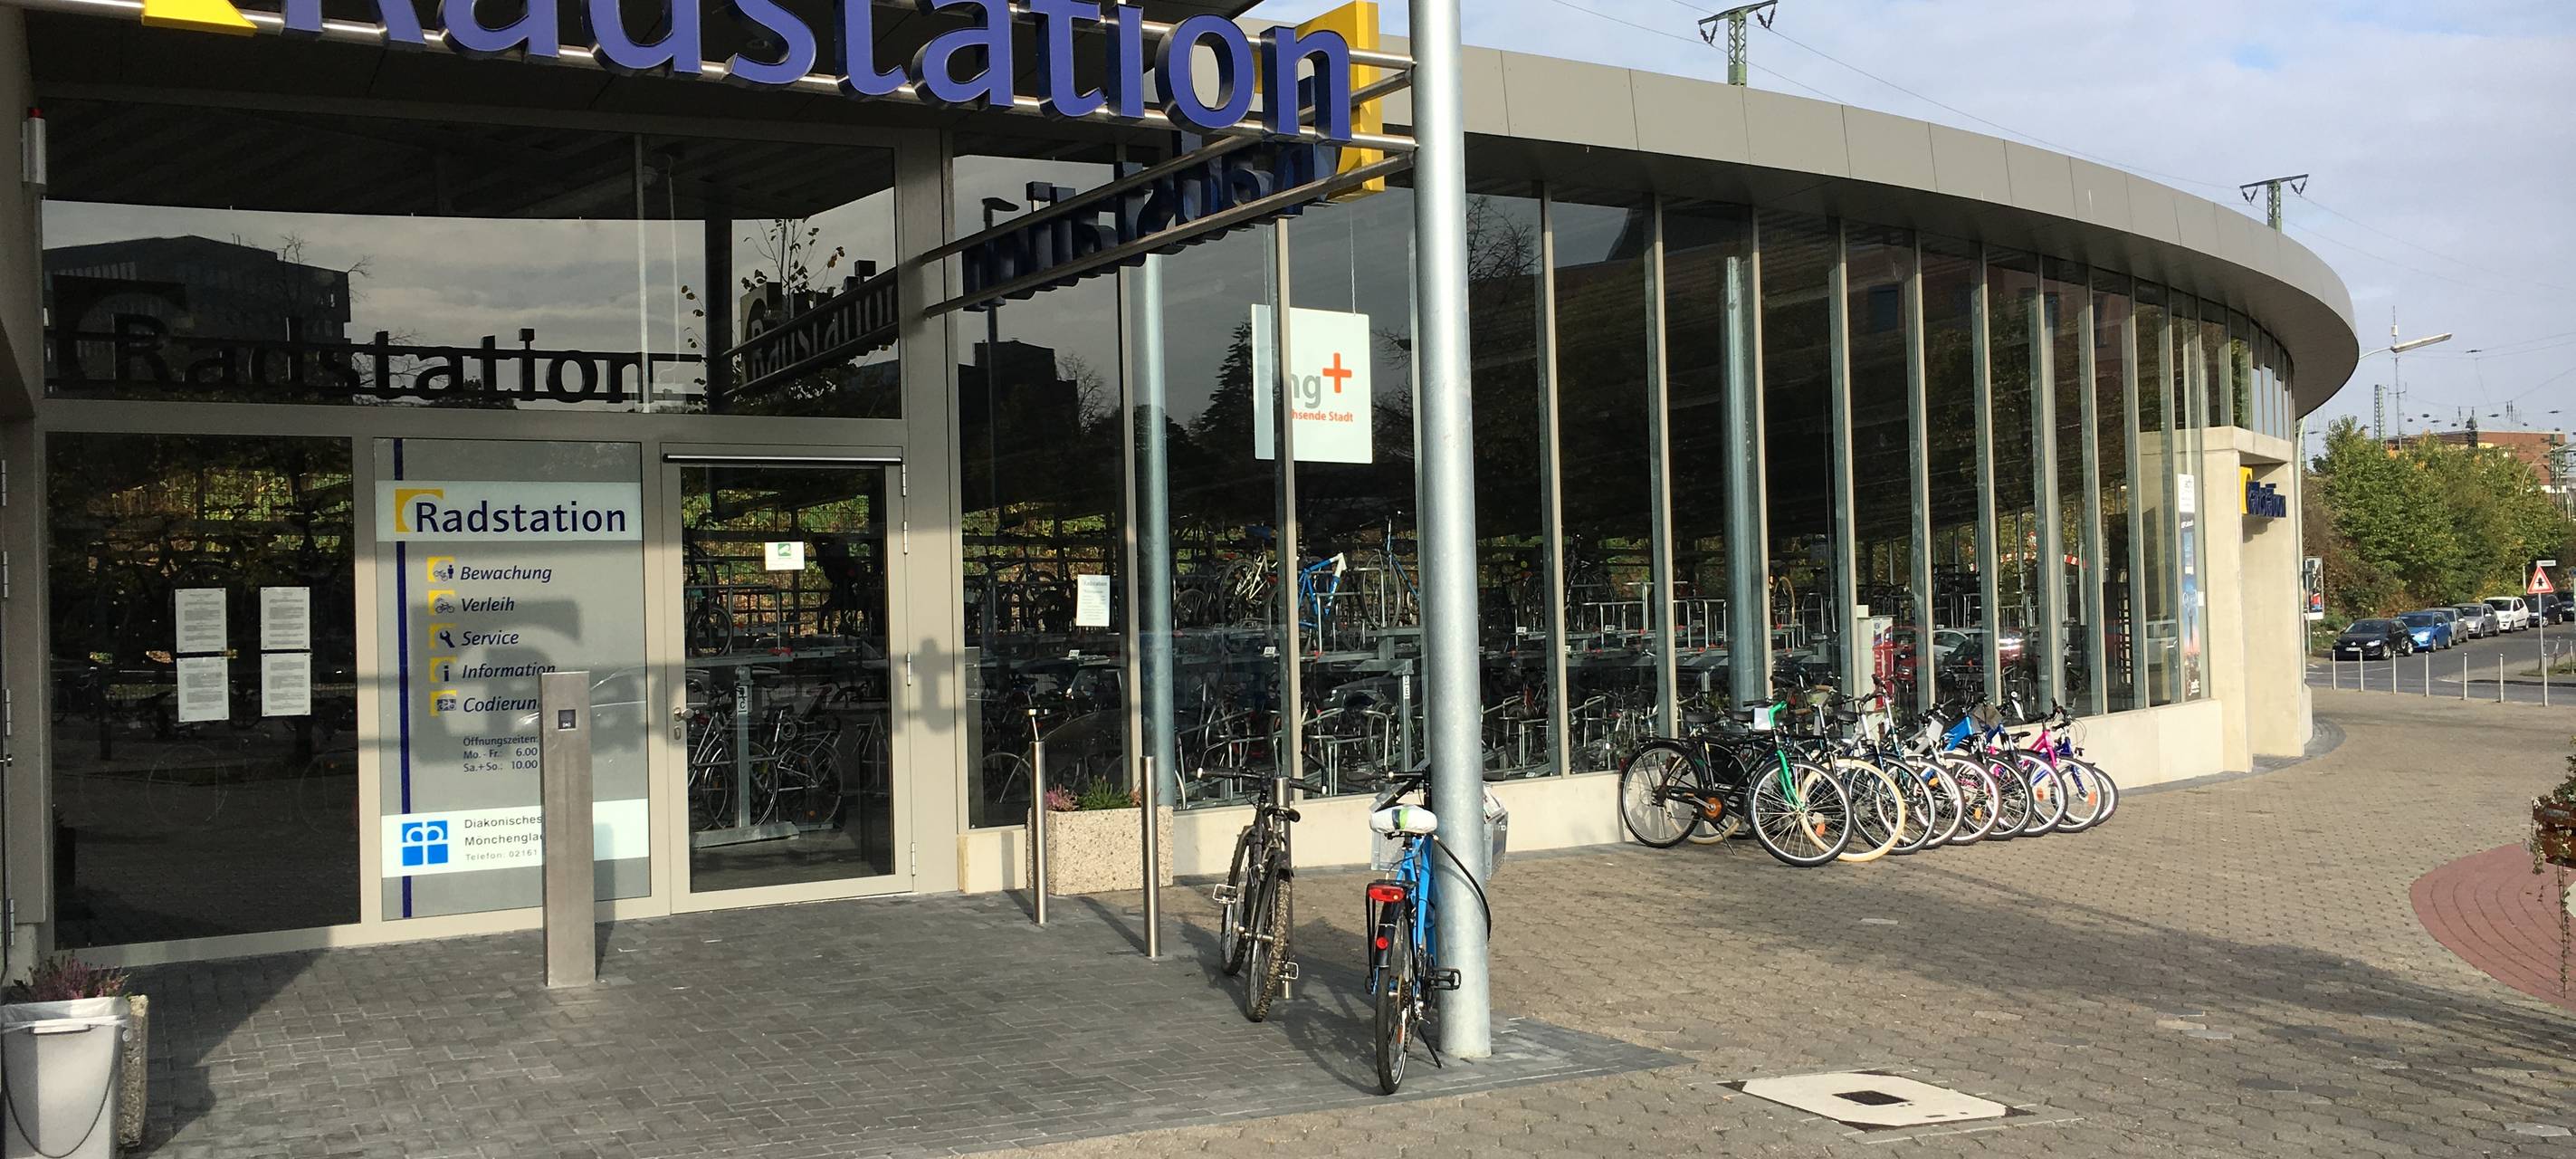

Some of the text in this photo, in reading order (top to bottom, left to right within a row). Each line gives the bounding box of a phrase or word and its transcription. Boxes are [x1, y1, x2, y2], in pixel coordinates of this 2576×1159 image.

[281, 0, 1352, 144] station
[1329, 411, 1354, 422] Stadt
[415, 501, 625, 532] Radstation
[461, 565, 552, 583] Bewachung
[462, 597, 515, 612] Verleih
[462, 630, 520, 647] Service
[463, 662, 556, 678] Information
[463, 696, 539, 713] Codierun
[515, 747, 538, 757] 6.00
[512, 760, 539, 770] 10.00
[464, 816, 543, 829] Diakonisches
[464, 833, 543, 846] Mönchengla
[465, 849, 537, 861] Telefon: 02161
